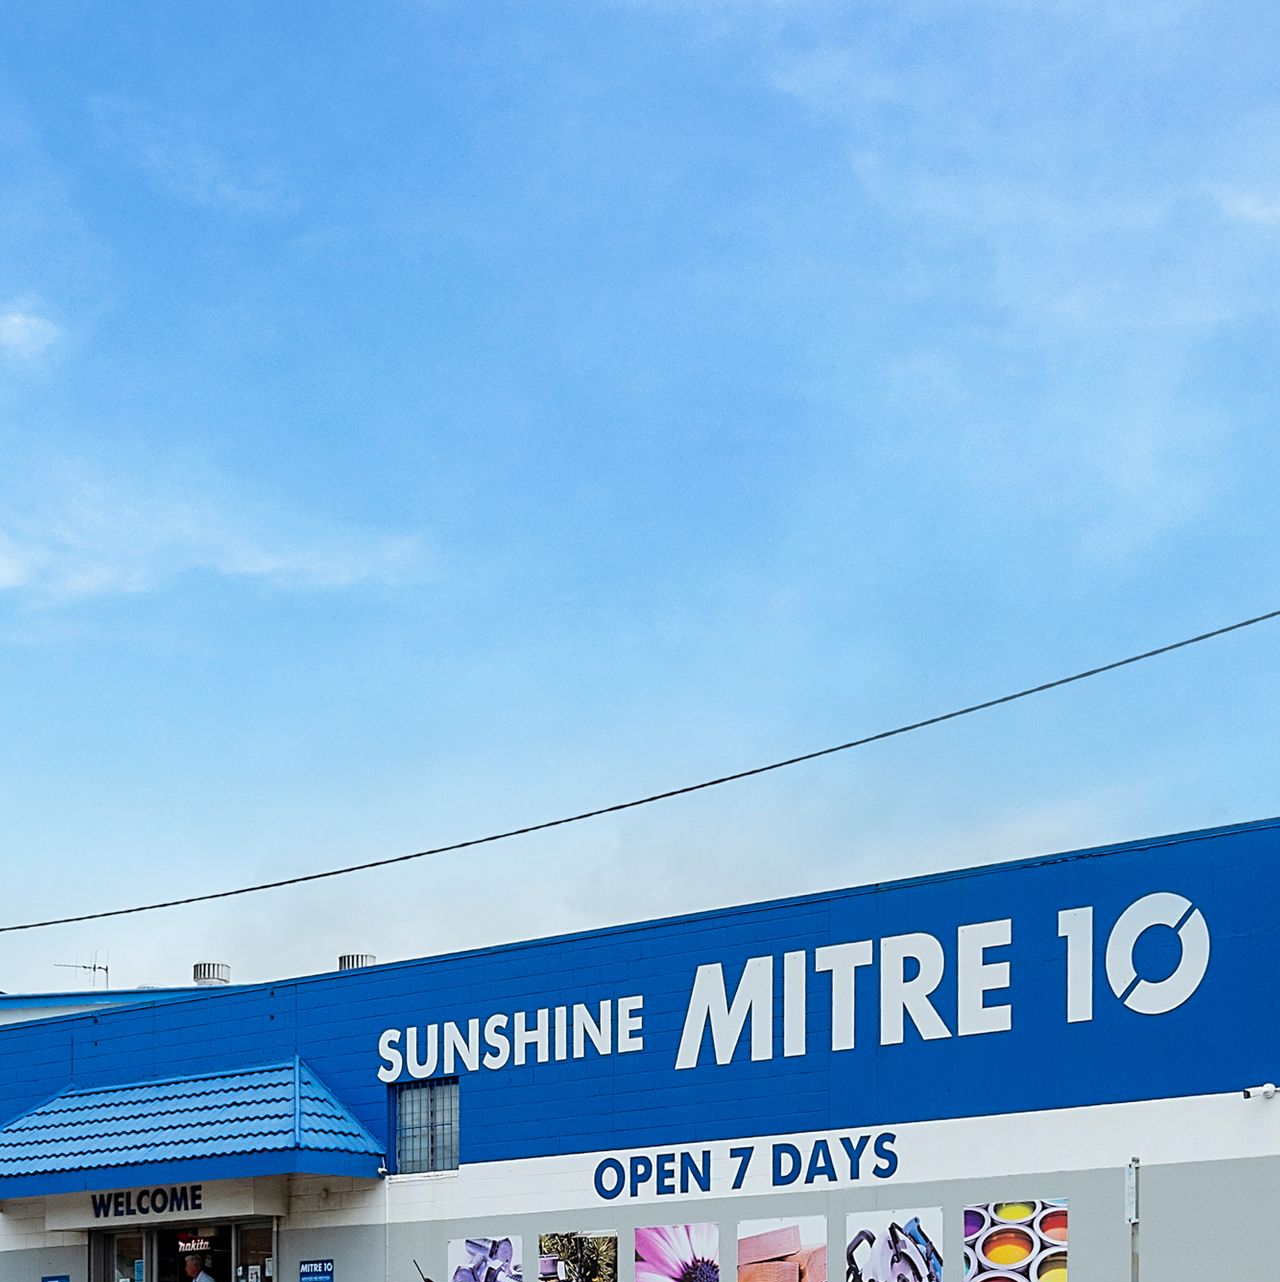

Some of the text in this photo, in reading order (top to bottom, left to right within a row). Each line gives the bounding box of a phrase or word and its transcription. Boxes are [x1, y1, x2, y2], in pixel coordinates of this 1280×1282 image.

[377, 891, 1211, 1084] SUNSHINE MITRE 10
[593, 1132, 899, 1200] OPEN 7 DAYS
[91, 1184, 203, 1218] WELCOME
[300, 1262, 333, 1273] MITRE 10
